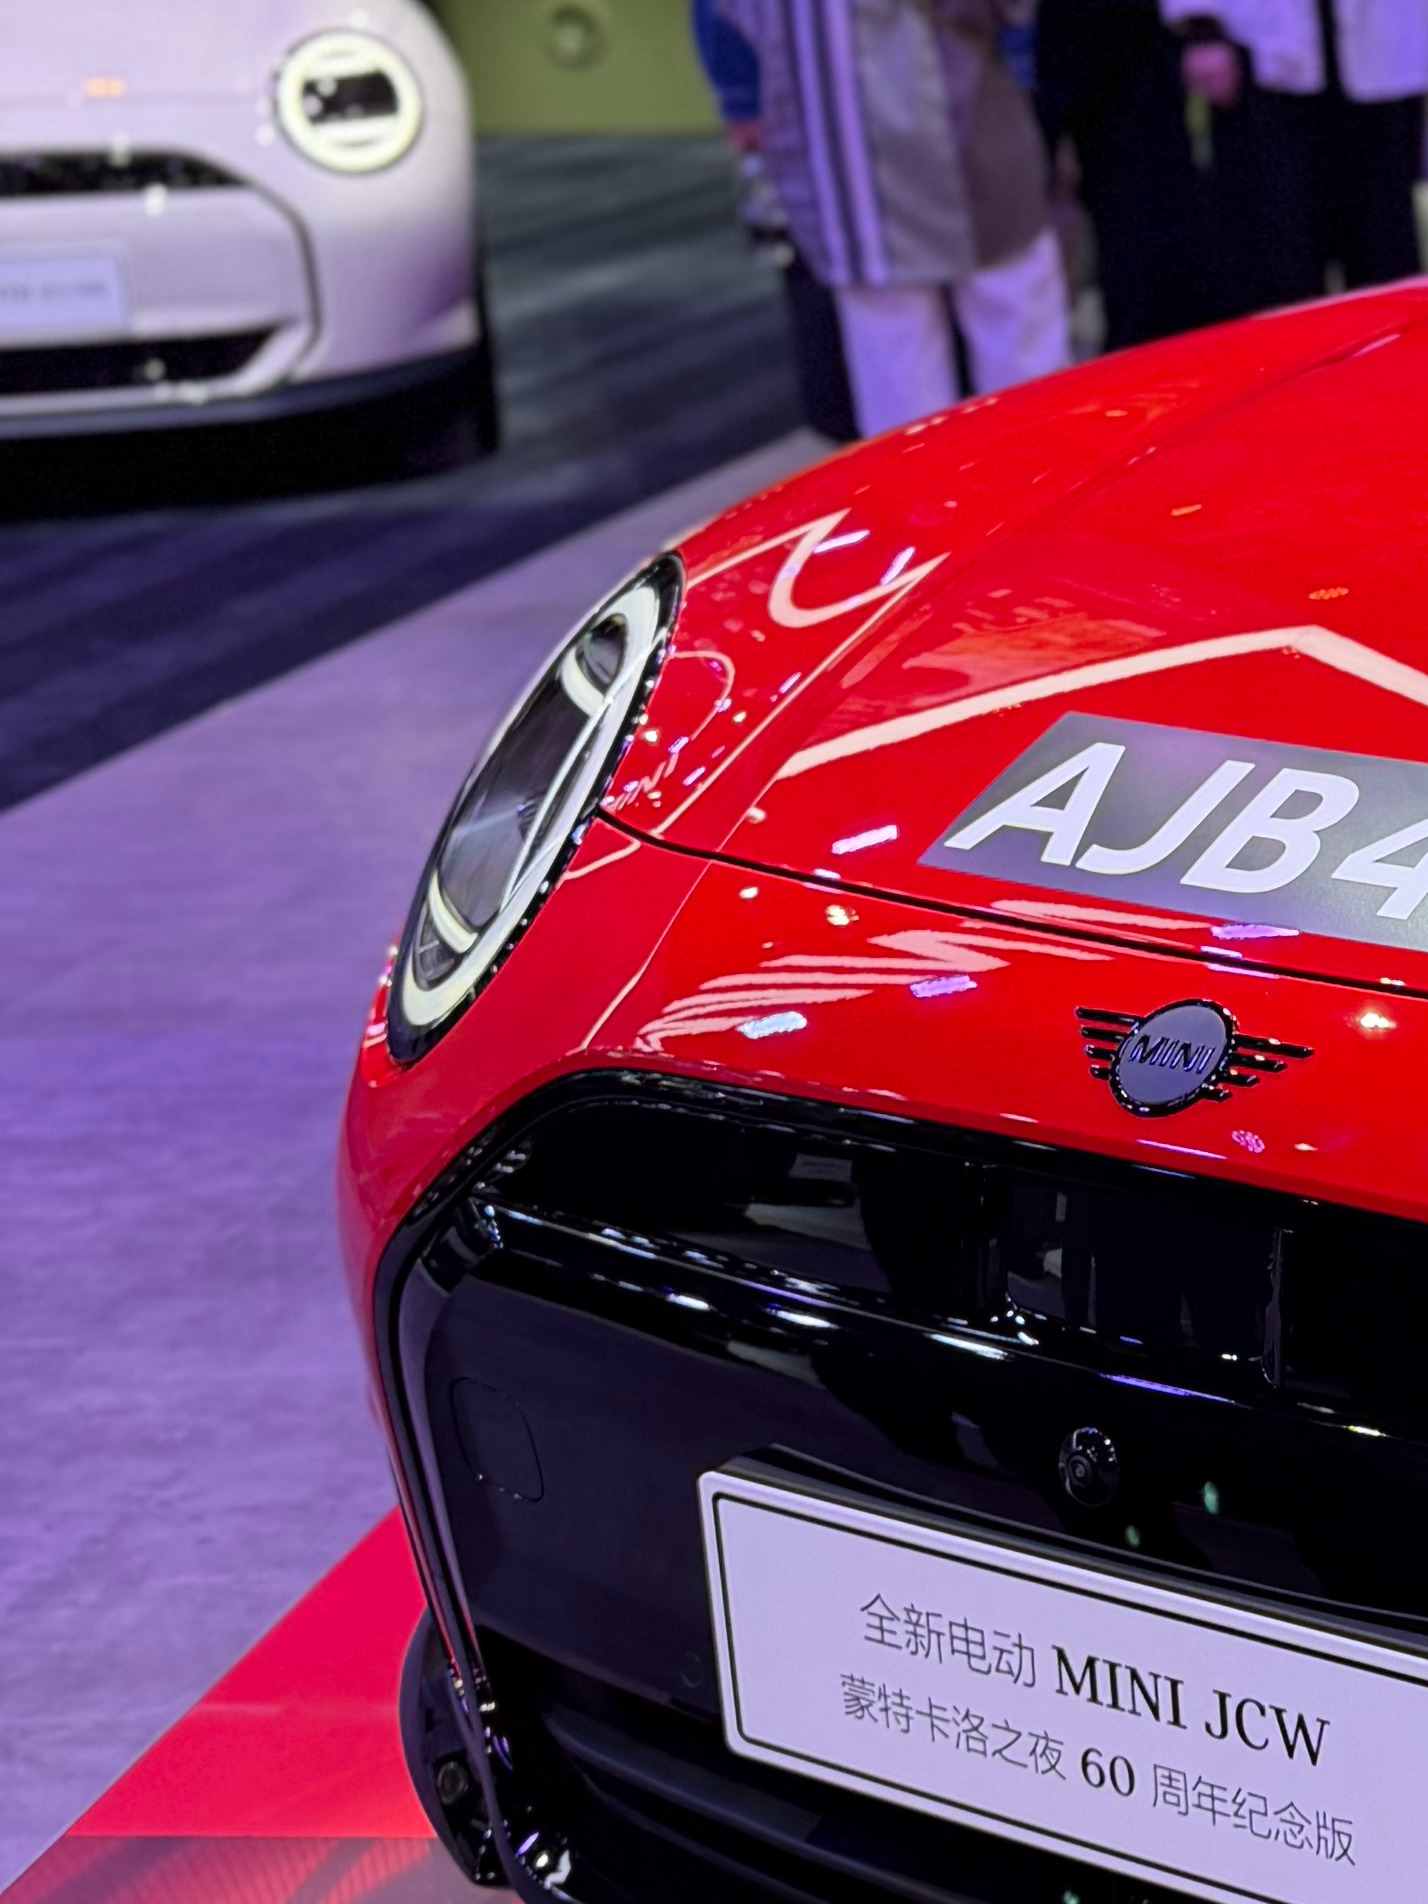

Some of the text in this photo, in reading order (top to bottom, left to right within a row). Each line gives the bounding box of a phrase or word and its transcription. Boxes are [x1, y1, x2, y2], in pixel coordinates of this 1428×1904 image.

[1128, 1034, 1216, 1074] MINI
[859, 1593, 1331, 1767] 全新电动 MINI JCW
[839, 1672, 1356, 1867] 蒙特卡洛之夜 60 周年纪念版
